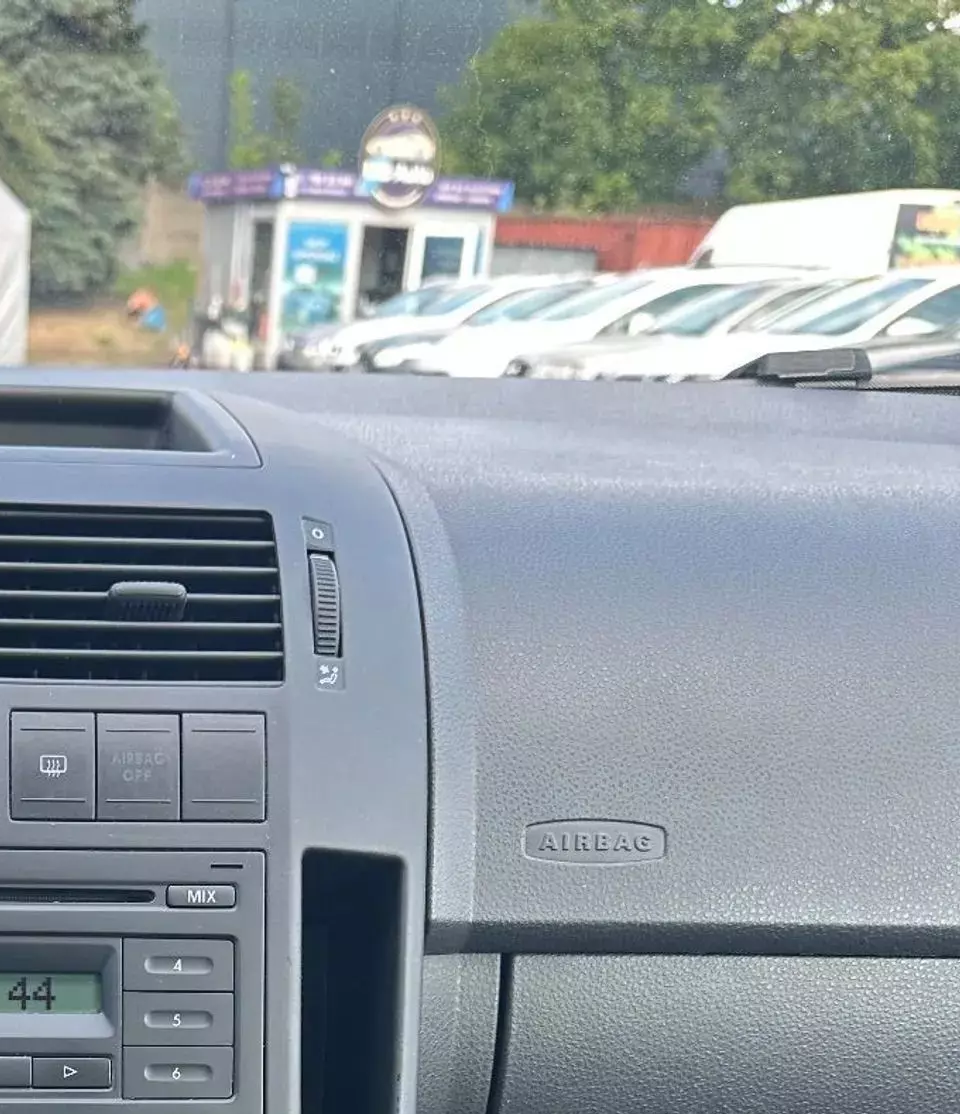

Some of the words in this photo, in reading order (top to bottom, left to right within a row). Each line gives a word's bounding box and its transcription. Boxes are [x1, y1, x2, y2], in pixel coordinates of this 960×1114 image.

[122, 770, 152, 782] OFF
[538, 831, 654, 852] AIRBAG
[187, 889, 216, 904] MIX
[173, 959, 183, 972] 4
[172, 1014, 182, 1027] 5
[172, 1067, 182, 1079] 6
